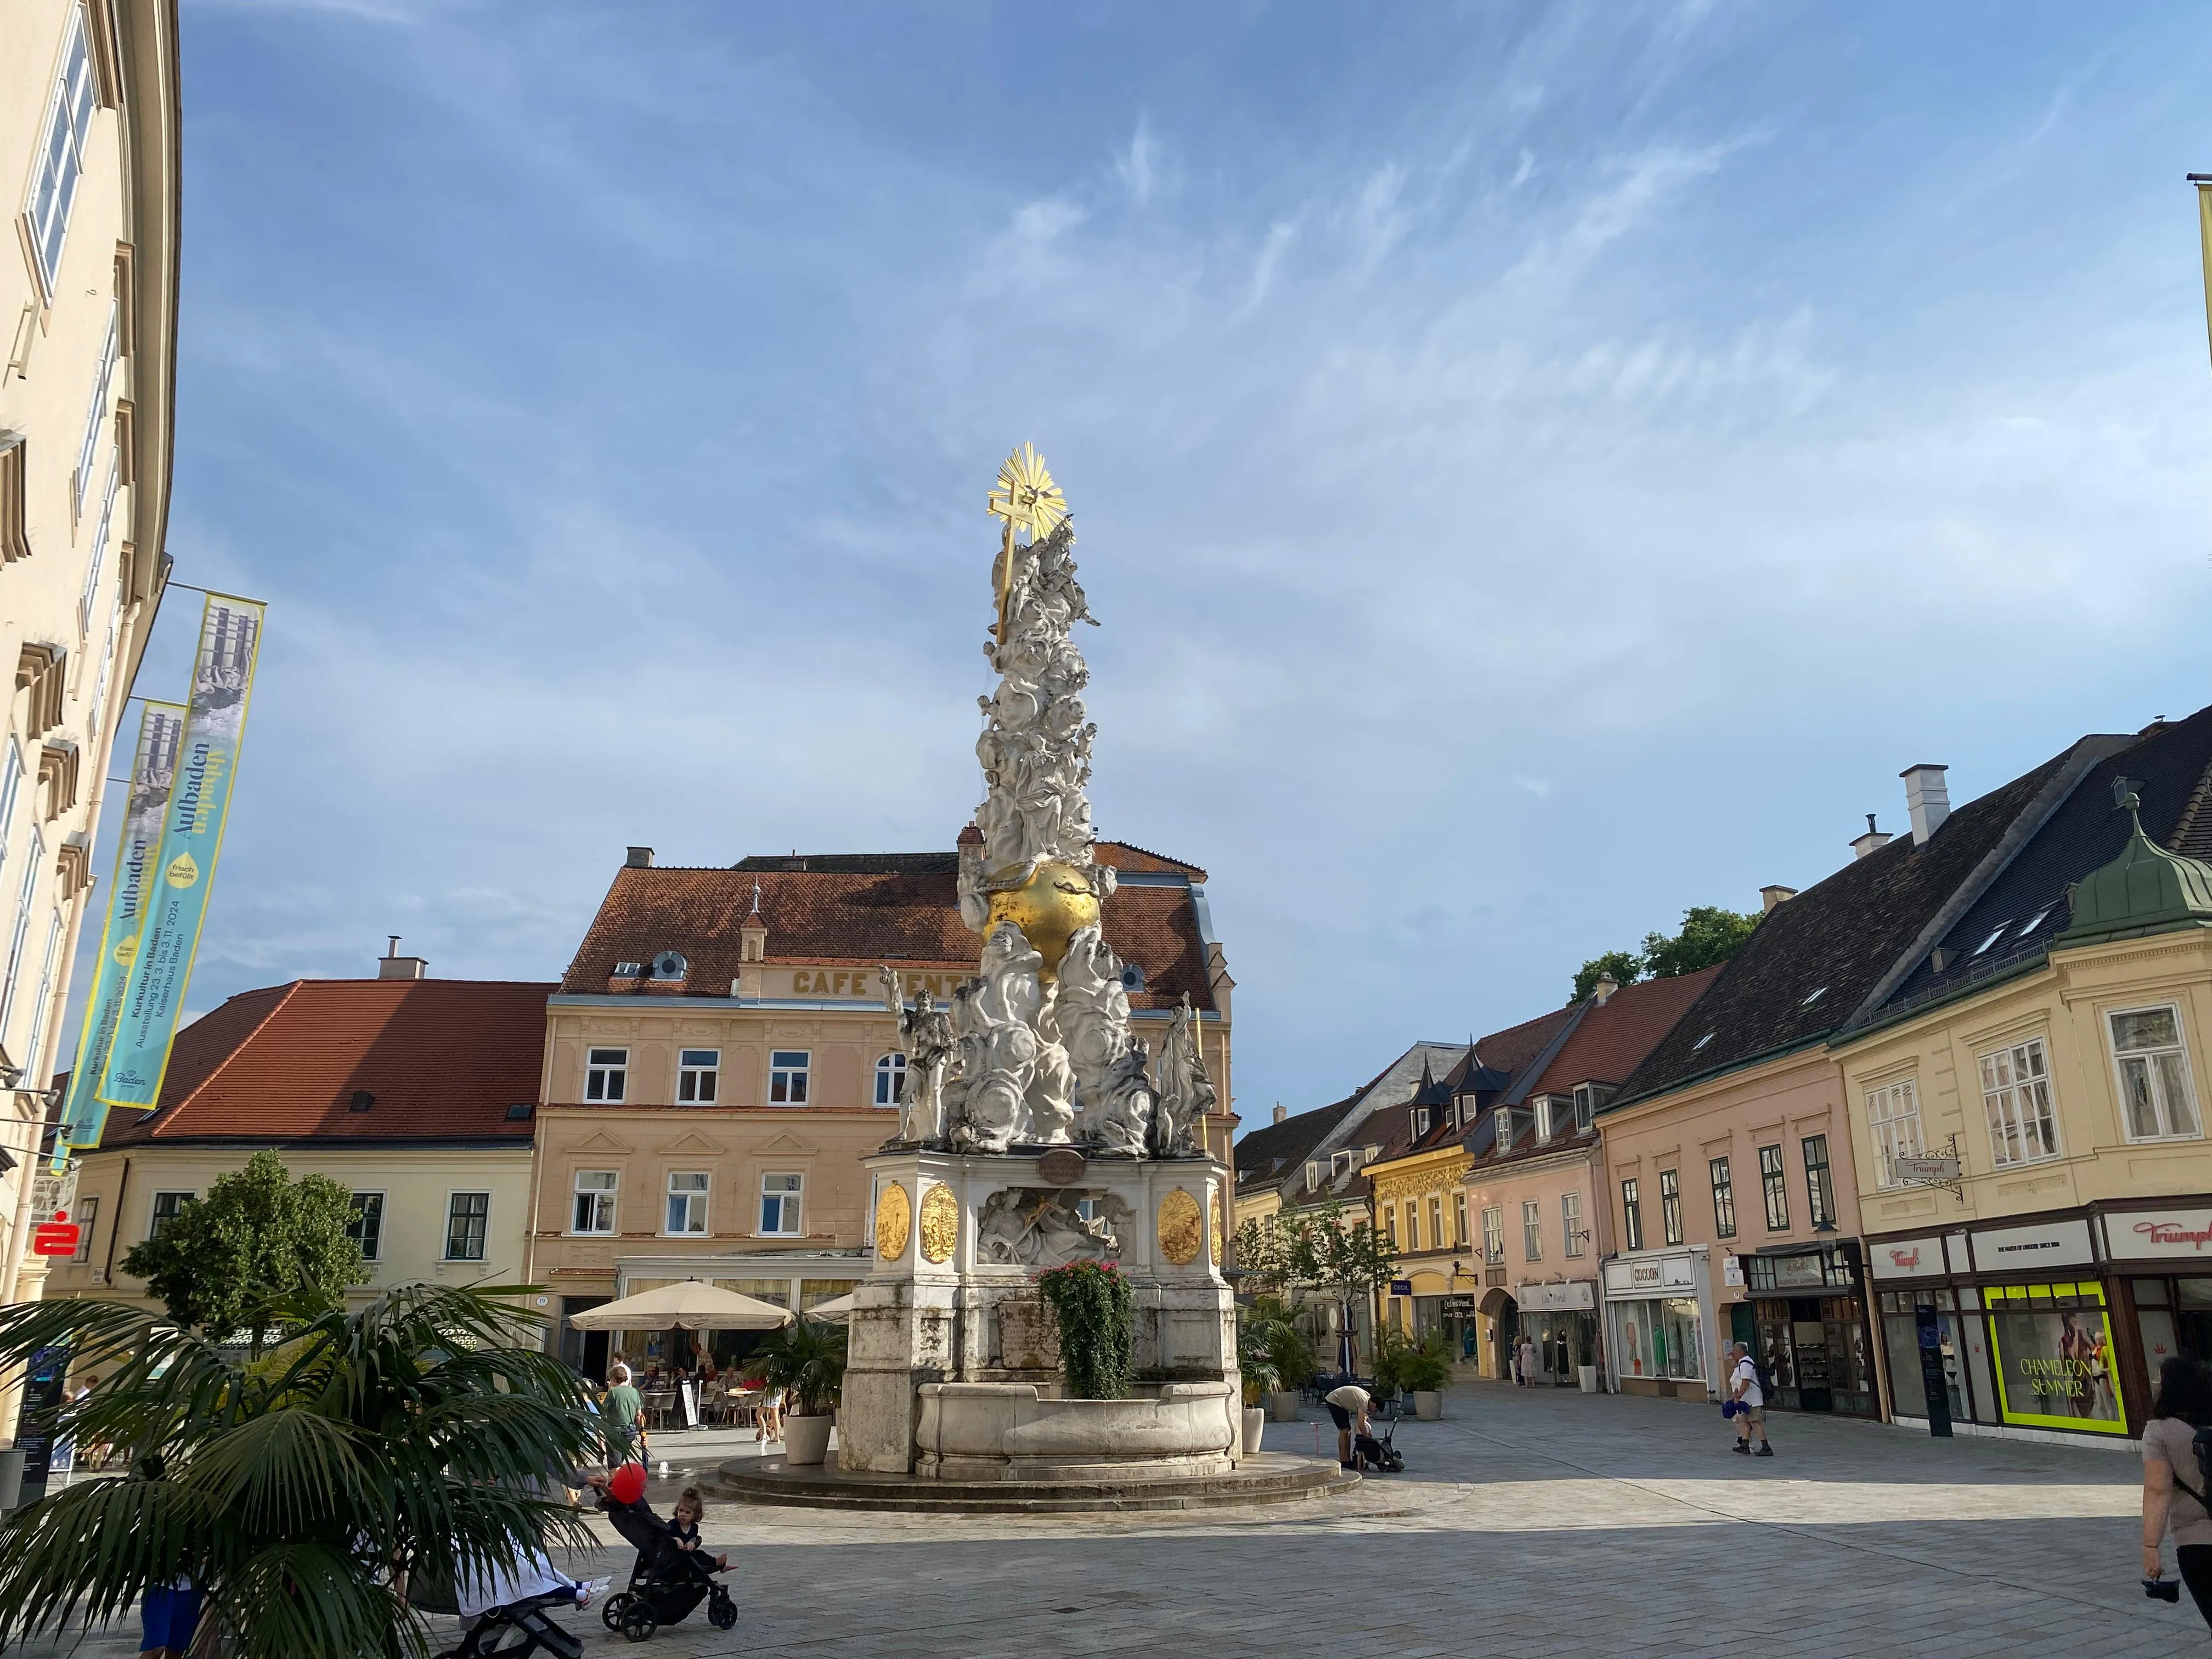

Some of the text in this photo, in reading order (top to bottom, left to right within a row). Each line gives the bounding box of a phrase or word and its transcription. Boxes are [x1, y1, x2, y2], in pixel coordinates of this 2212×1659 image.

[173, 743, 209, 839] Aufbaden
[170, 871, 194, 880] befüllt
[172, 864, 194, 872] frisch
[146, 927, 162, 959] Baden
[136, 991, 159, 1048] Ausstellung
[150, 975, 161, 991] 23.
[157, 949, 168, 964] bis
[166, 900, 180, 927] 2024
[144, 960, 153, 970] in
[155, 933, 184, 1018] Kaiserhaus Baden
[131, 970, 150, 1018] Kurkultur
[89, 1035, 104, 1075] Kurkultur
[114, 1073, 146, 1085] Baden
[1905, 1161, 1945, 1176] Triumph
[1889, 1247, 1918, 1272] Triumph
[1635, 1267, 1659, 1281] COCOON
[2021, 1358, 2092, 1376] CHAMELEON
[2032, 1379, 2084, 1397] SUMMER
